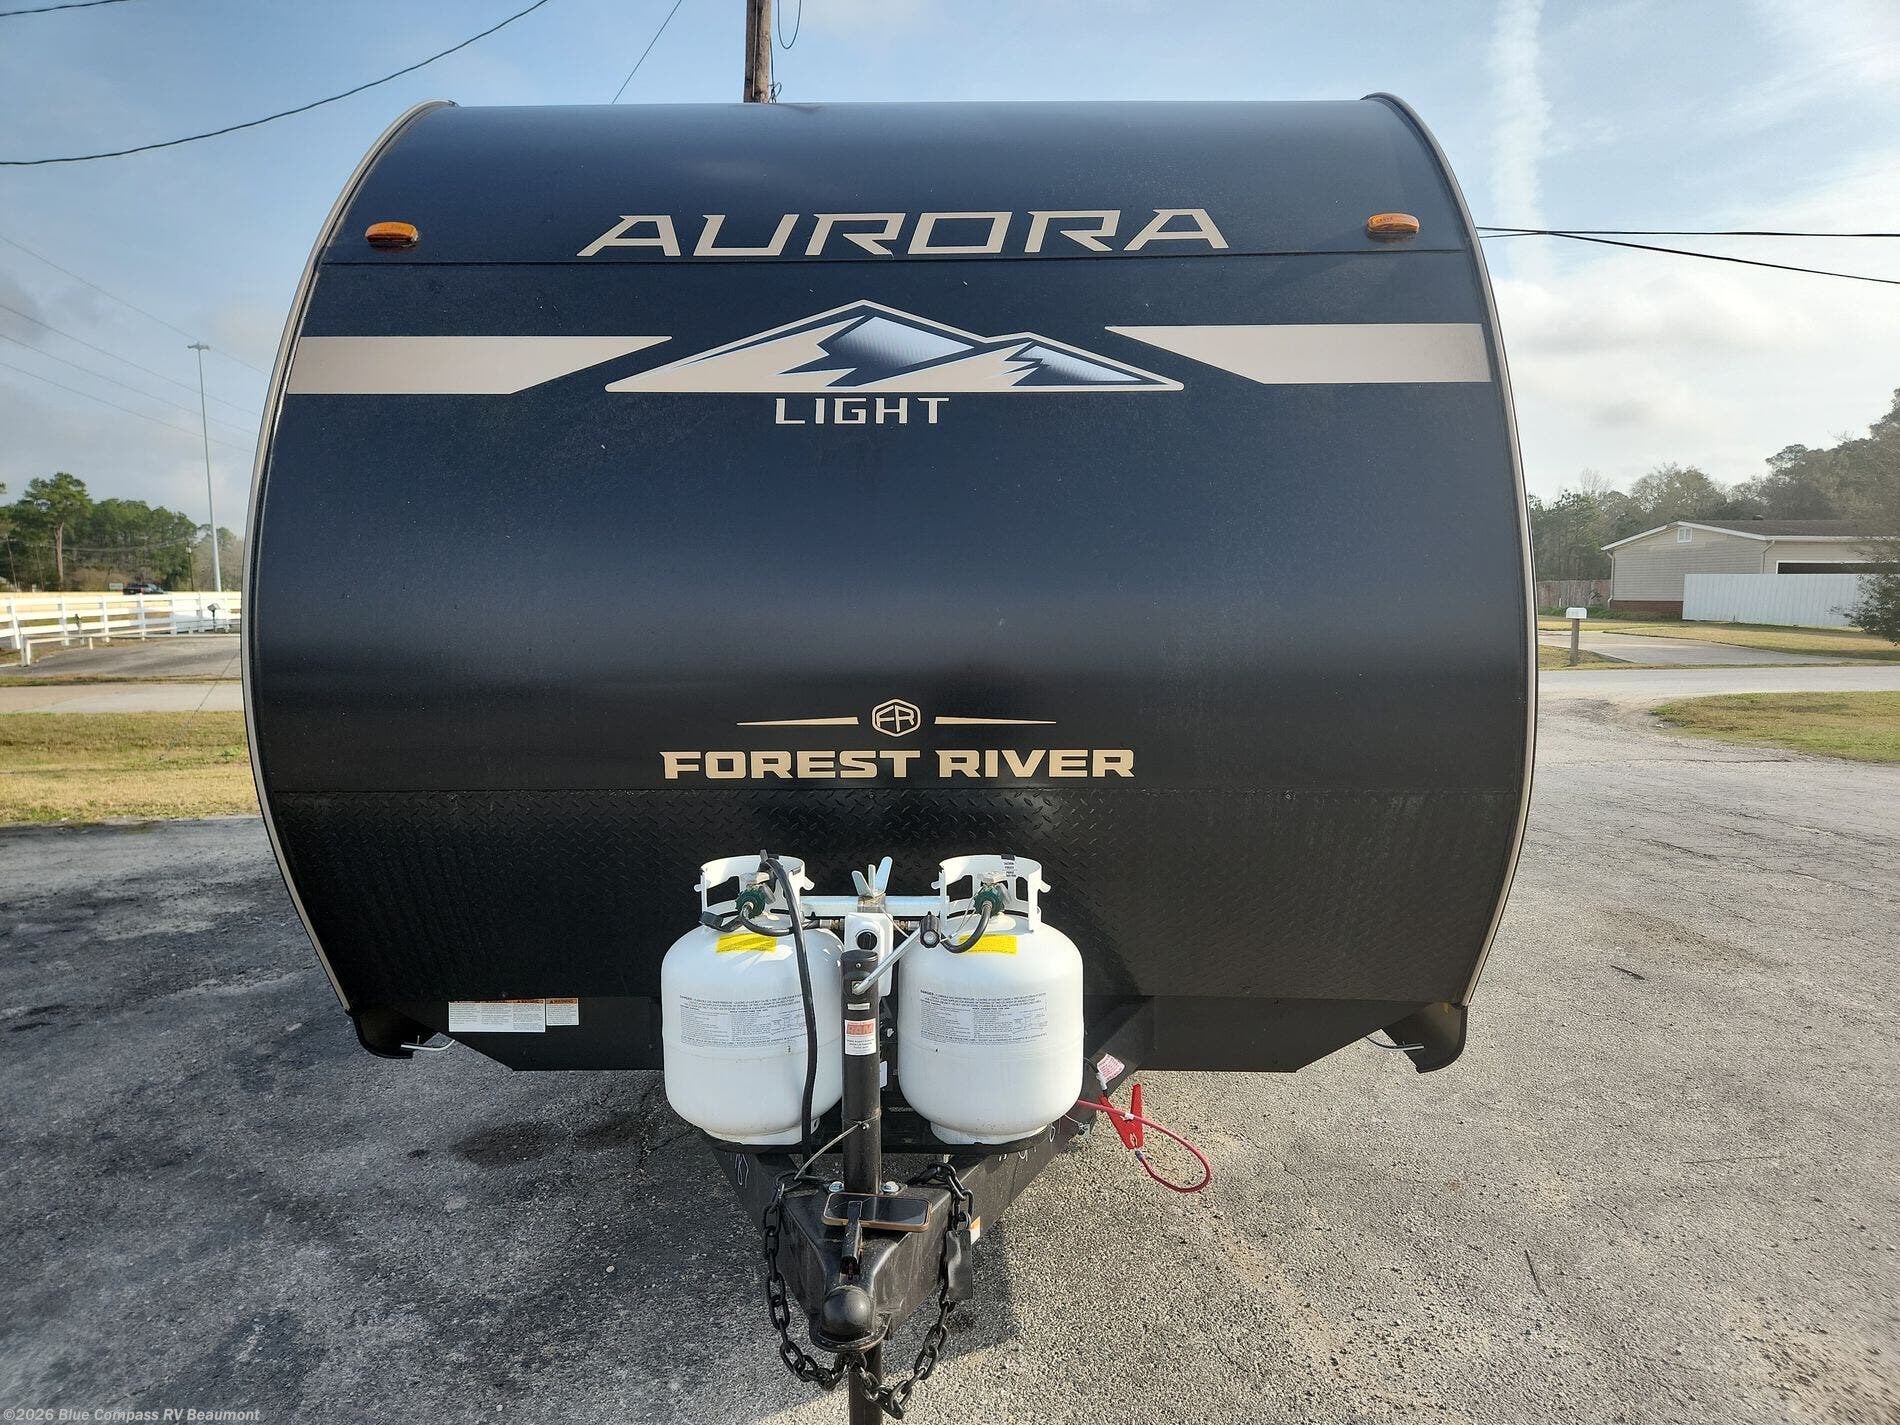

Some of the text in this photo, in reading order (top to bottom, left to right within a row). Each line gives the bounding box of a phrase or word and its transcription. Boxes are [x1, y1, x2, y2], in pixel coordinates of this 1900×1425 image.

[577, 208, 1230, 257] AURORA
[775, 397, 950, 425] LIGHT
[660, 749, 1135, 780] FOREST RIVER
